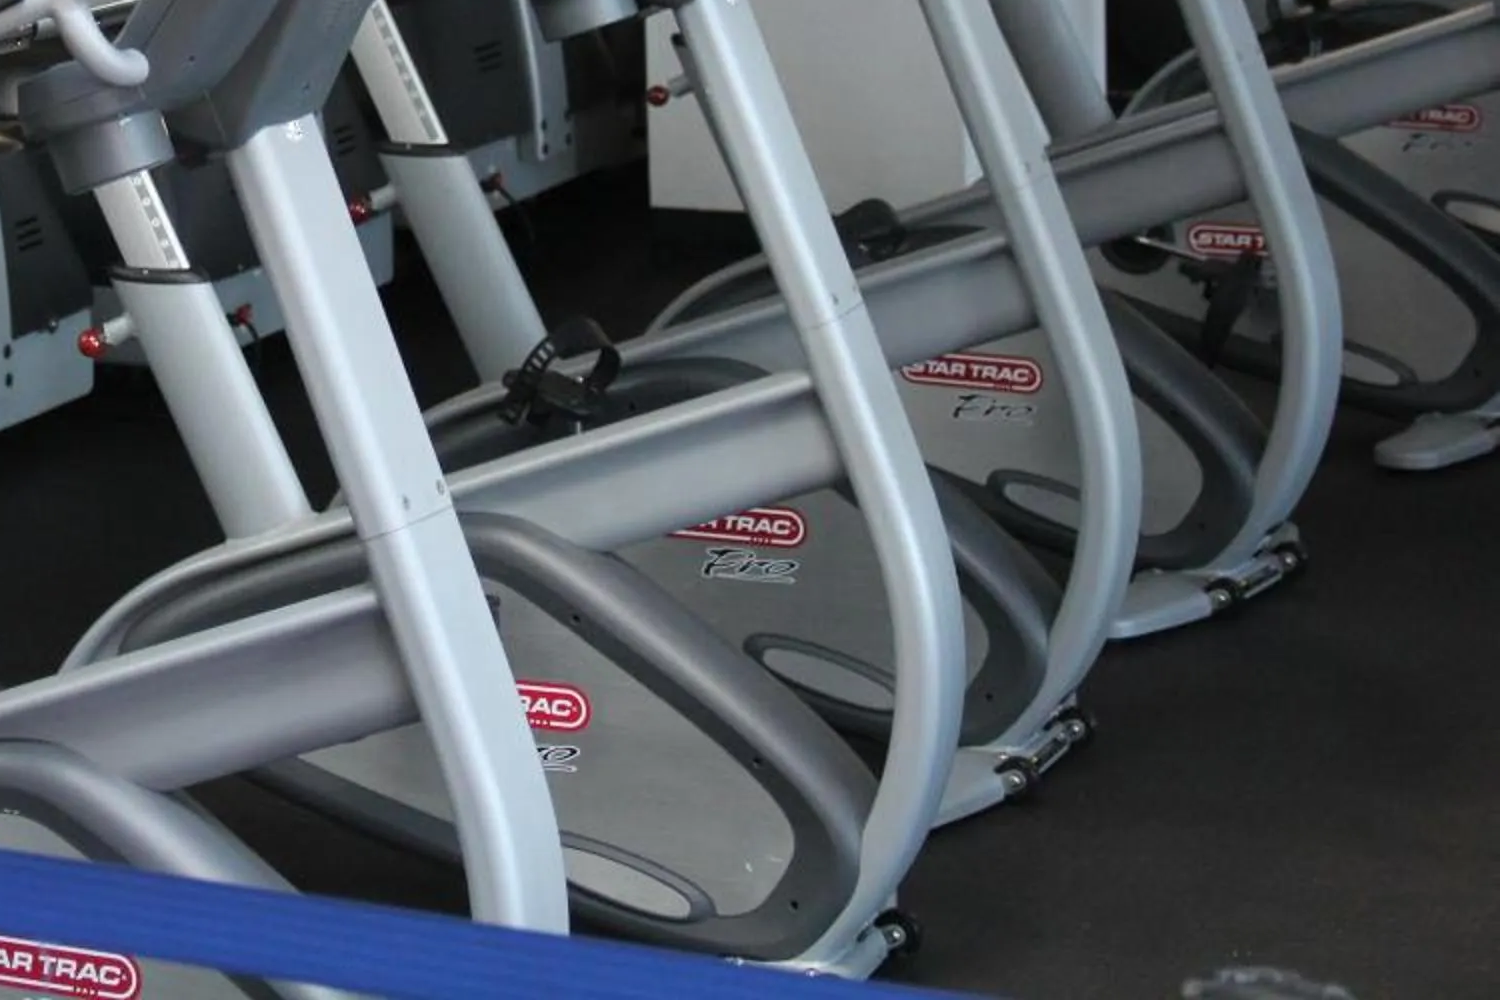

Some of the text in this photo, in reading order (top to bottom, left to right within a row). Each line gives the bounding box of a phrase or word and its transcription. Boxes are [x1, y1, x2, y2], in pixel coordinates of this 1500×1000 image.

[1199, 232, 1252, 247] STAR
[968, 363, 1029, 382] TRAC
[724, 515, 791, 535] TRAC
[38, 953, 121, 986] TRAC
